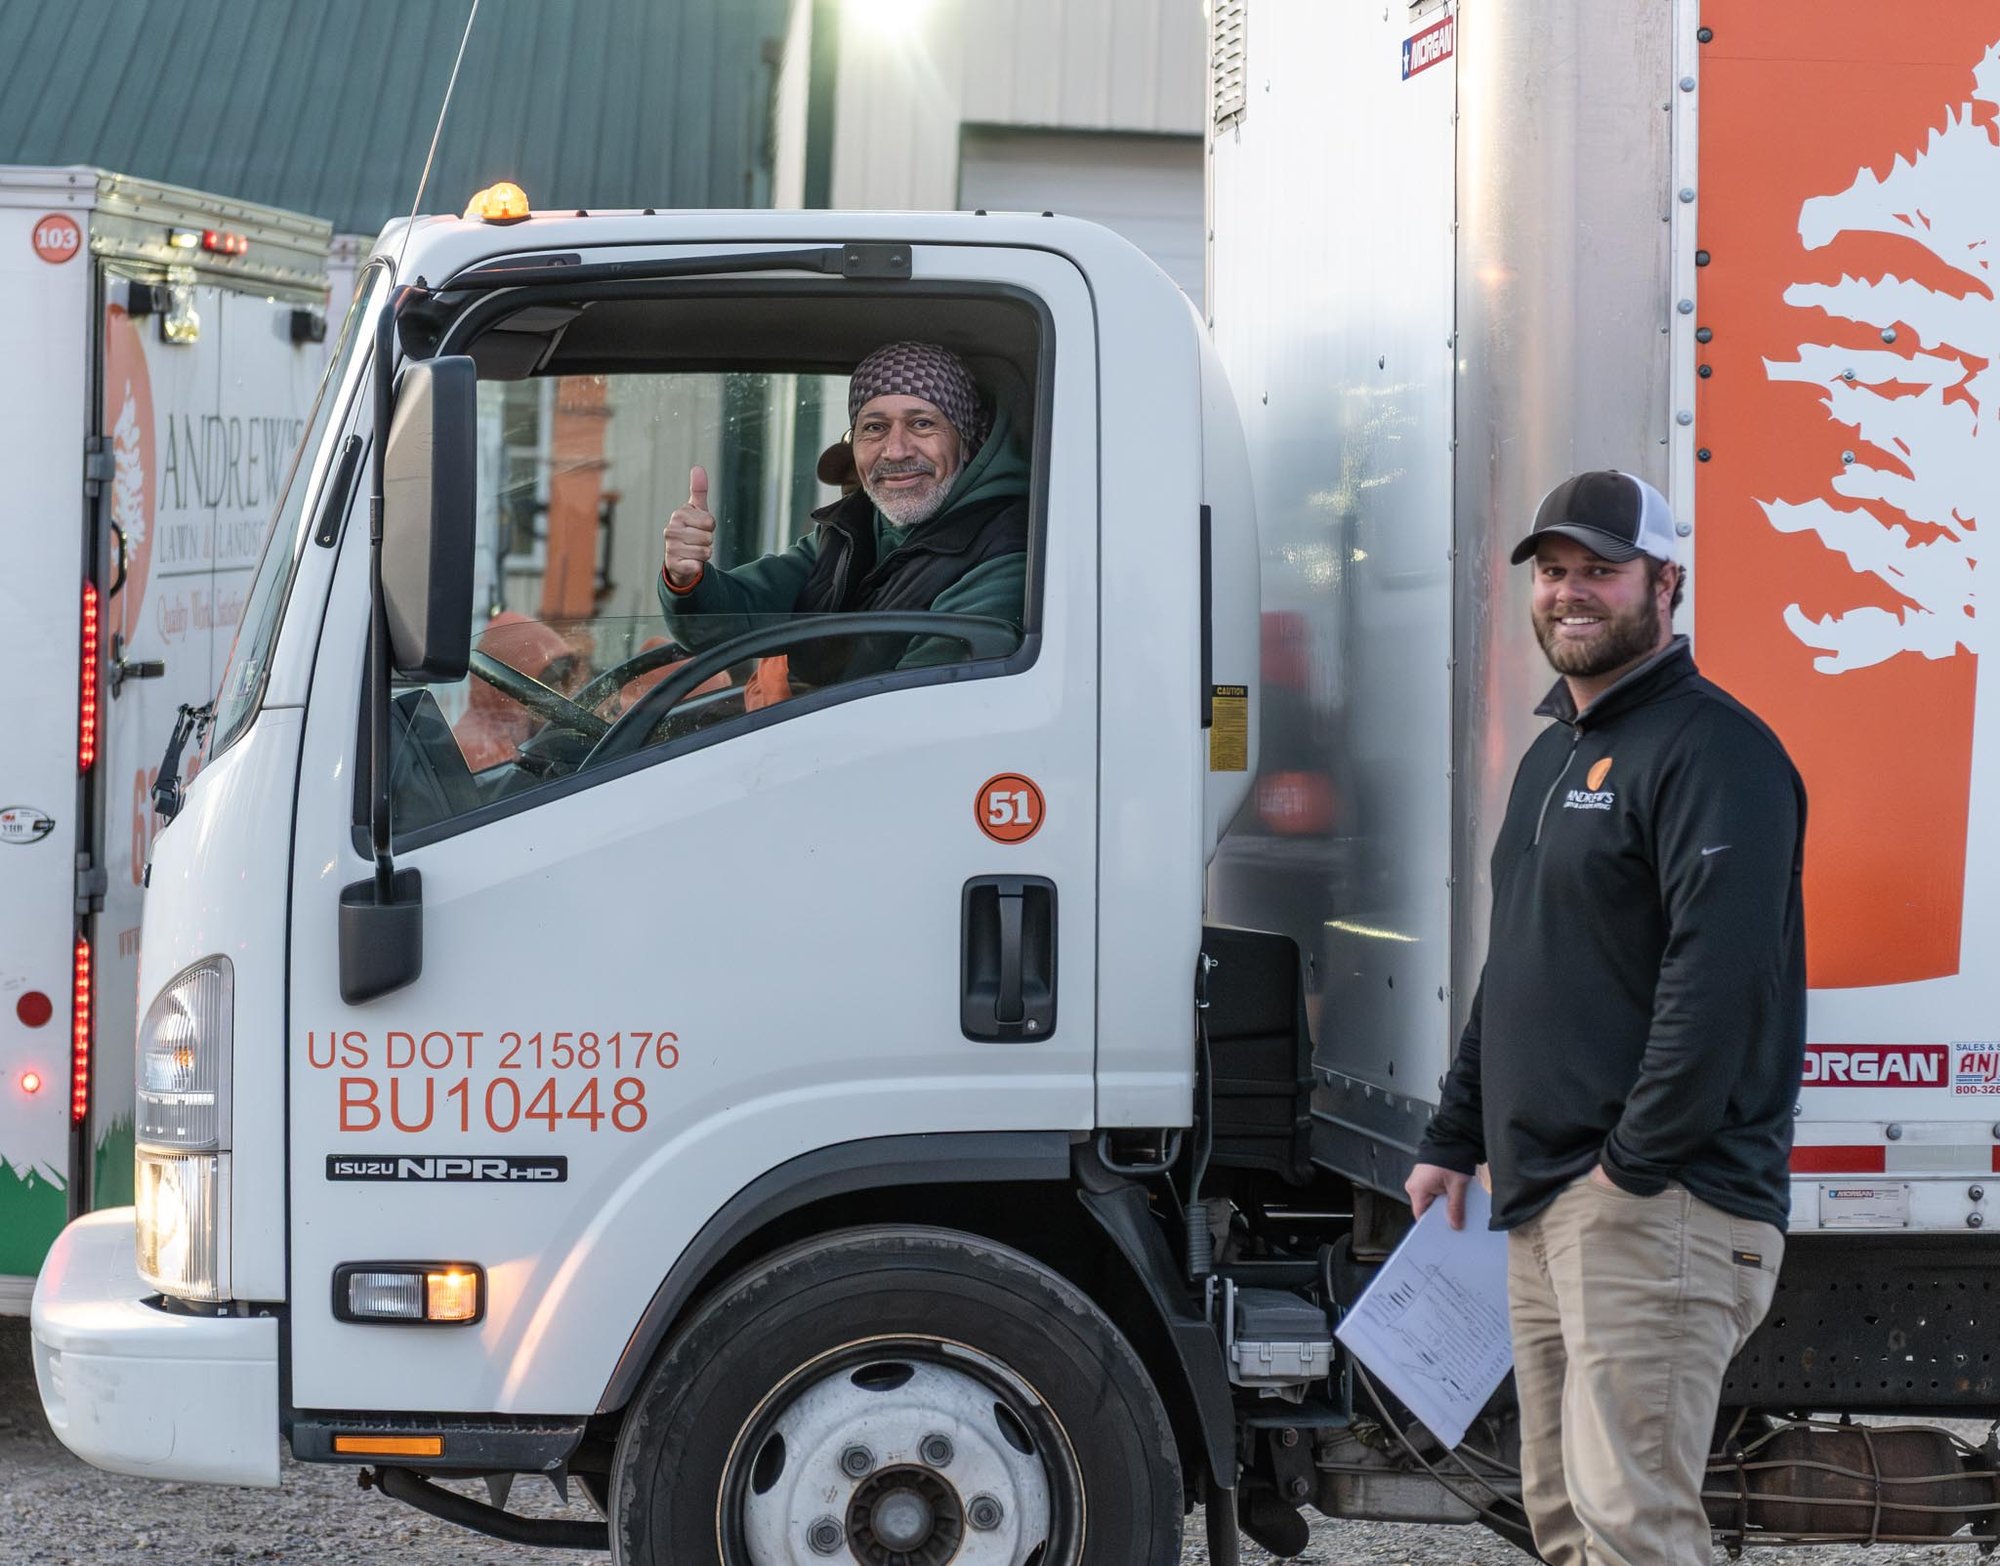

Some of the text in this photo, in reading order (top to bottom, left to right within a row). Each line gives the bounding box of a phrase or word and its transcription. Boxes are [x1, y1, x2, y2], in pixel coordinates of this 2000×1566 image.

[1410, 22, 1453, 71] MORGAN
[38, 228, 77, 249] 103
[160, 524, 198, 563] LAWN
[1217, 687, 1244, 695] CAUTION
[989, 791, 1031, 825] 51
[308, 1031, 680, 1069] US DOT 2158176
[1802, 1052, 1938, 1082] ORGAN
[339, 1077, 649, 1132] BU10448
[335, 1162, 394, 1175] ISUZU
